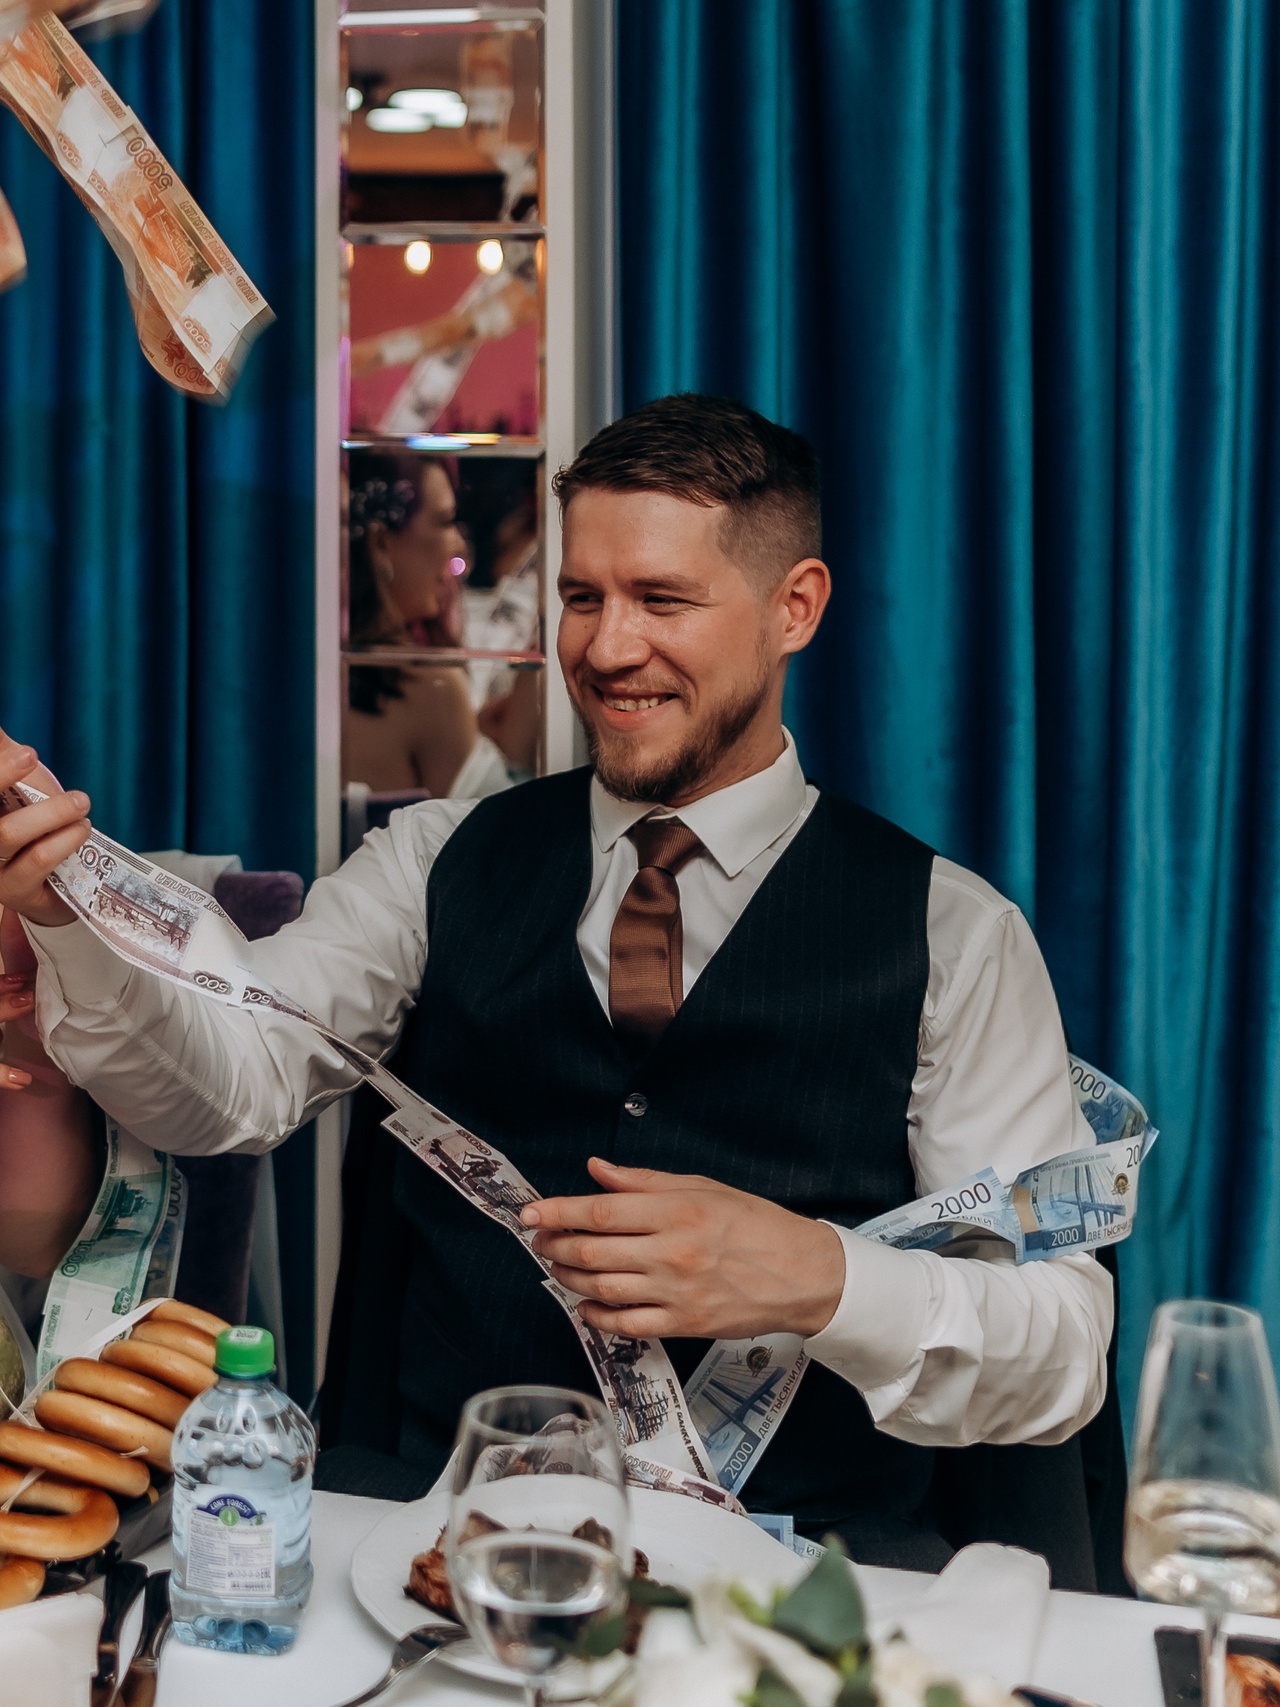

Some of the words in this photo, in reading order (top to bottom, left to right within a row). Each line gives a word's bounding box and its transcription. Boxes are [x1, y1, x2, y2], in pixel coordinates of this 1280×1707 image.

[125, 136, 174, 194] 5000
[182, 318, 212, 353] 5000
[154, 871, 207, 907] ДУБЛЕЙ
[195, 970, 232, 996] 500
[1069, 1060, 1107, 1101] 000
[931, 1181, 992, 1221] 2000
[1051, 1227, 1079, 1247] 2000
[60, 1239, 97, 1277] 1000
[758, 1413, 774, 1440] ДВЕ
[771, 1369, 799, 1414] ТЫСЯЧИ
[724, 1440, 755, 1481] 2000
[226, 1498, 252, 1514] FOREST
